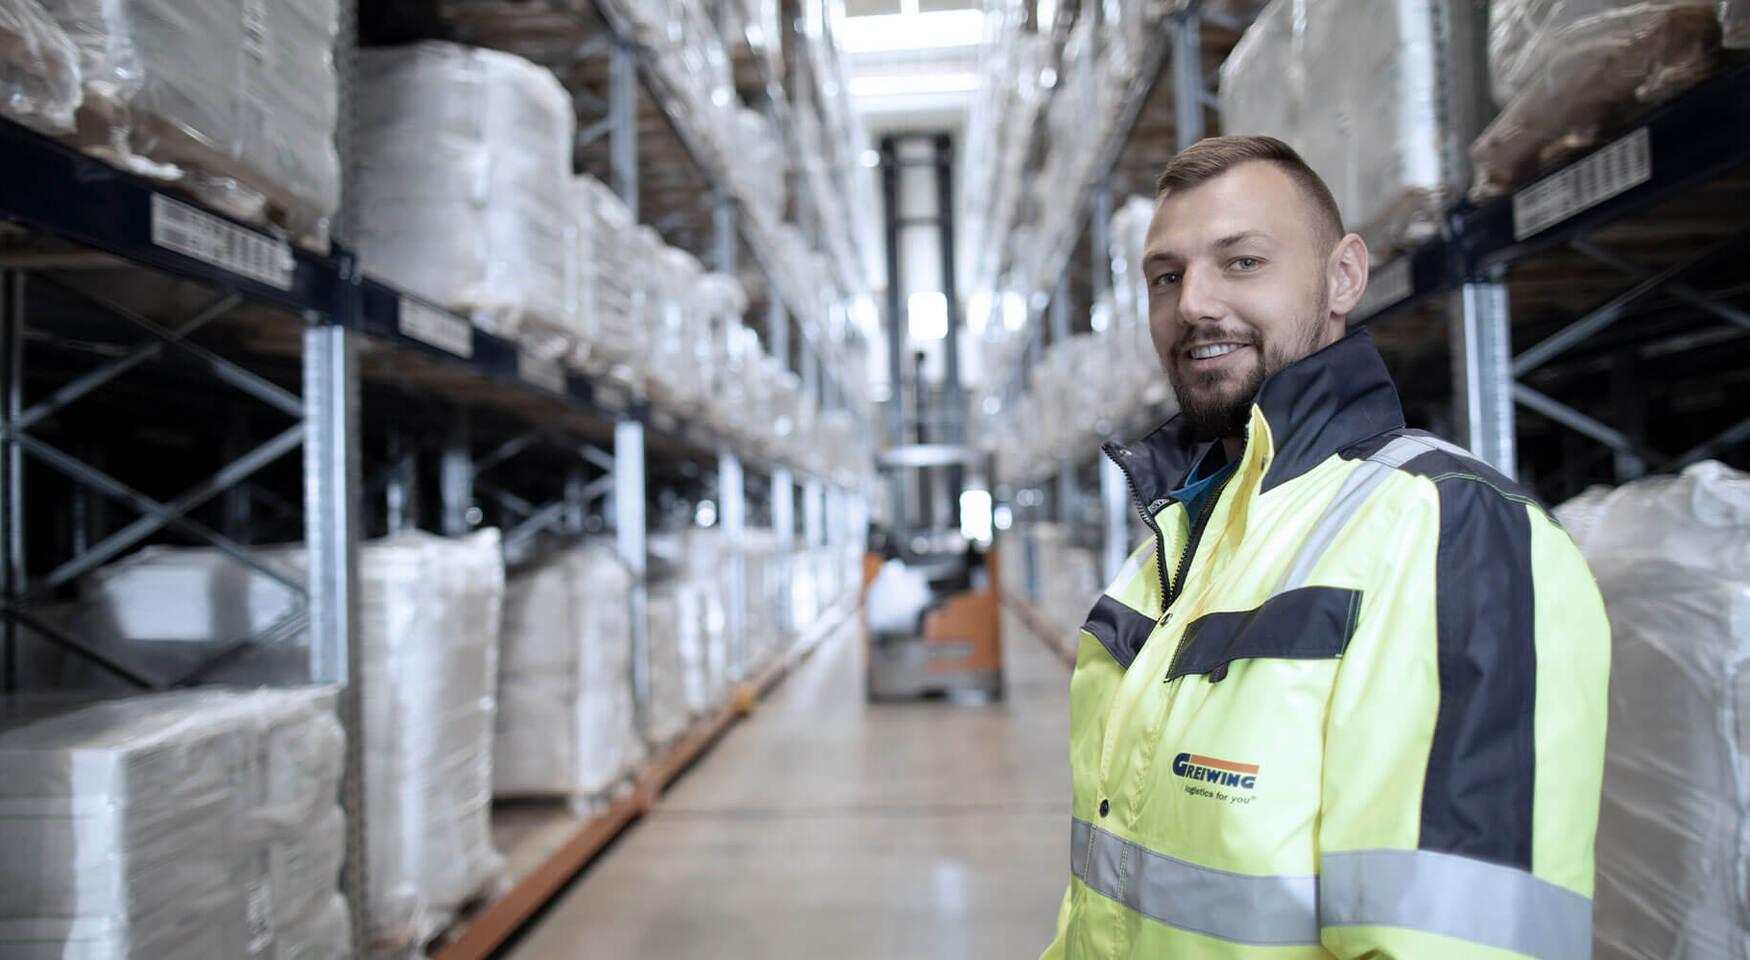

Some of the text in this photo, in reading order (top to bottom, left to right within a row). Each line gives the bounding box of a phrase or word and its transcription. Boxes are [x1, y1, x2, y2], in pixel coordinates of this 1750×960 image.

[1172, 752, 1256, 789] GREIWING
[1184, 784, 1214, 798] logistics
[1215, 791, 1228, 801] for
